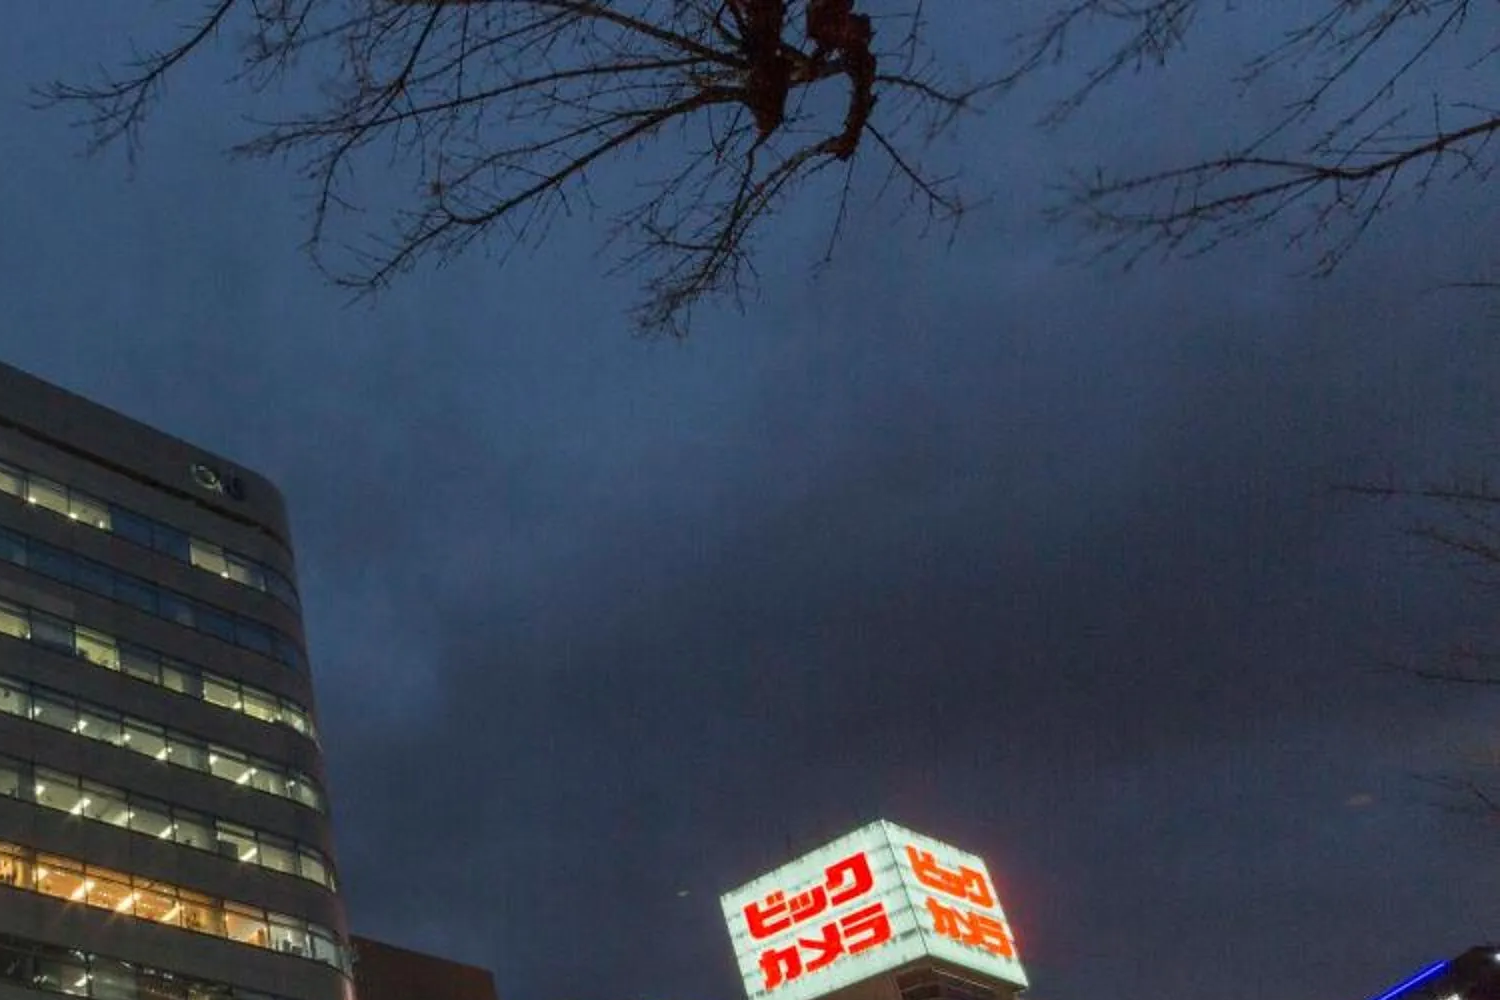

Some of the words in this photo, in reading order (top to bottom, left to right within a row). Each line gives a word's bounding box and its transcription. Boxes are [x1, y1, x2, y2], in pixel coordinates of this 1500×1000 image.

[742, 851, 874, 940] ビック
[905, 845, 994, 908] ビック
[758, 902, 892, 991] カメラ
[926, 896, 1013, 957] カメラ
